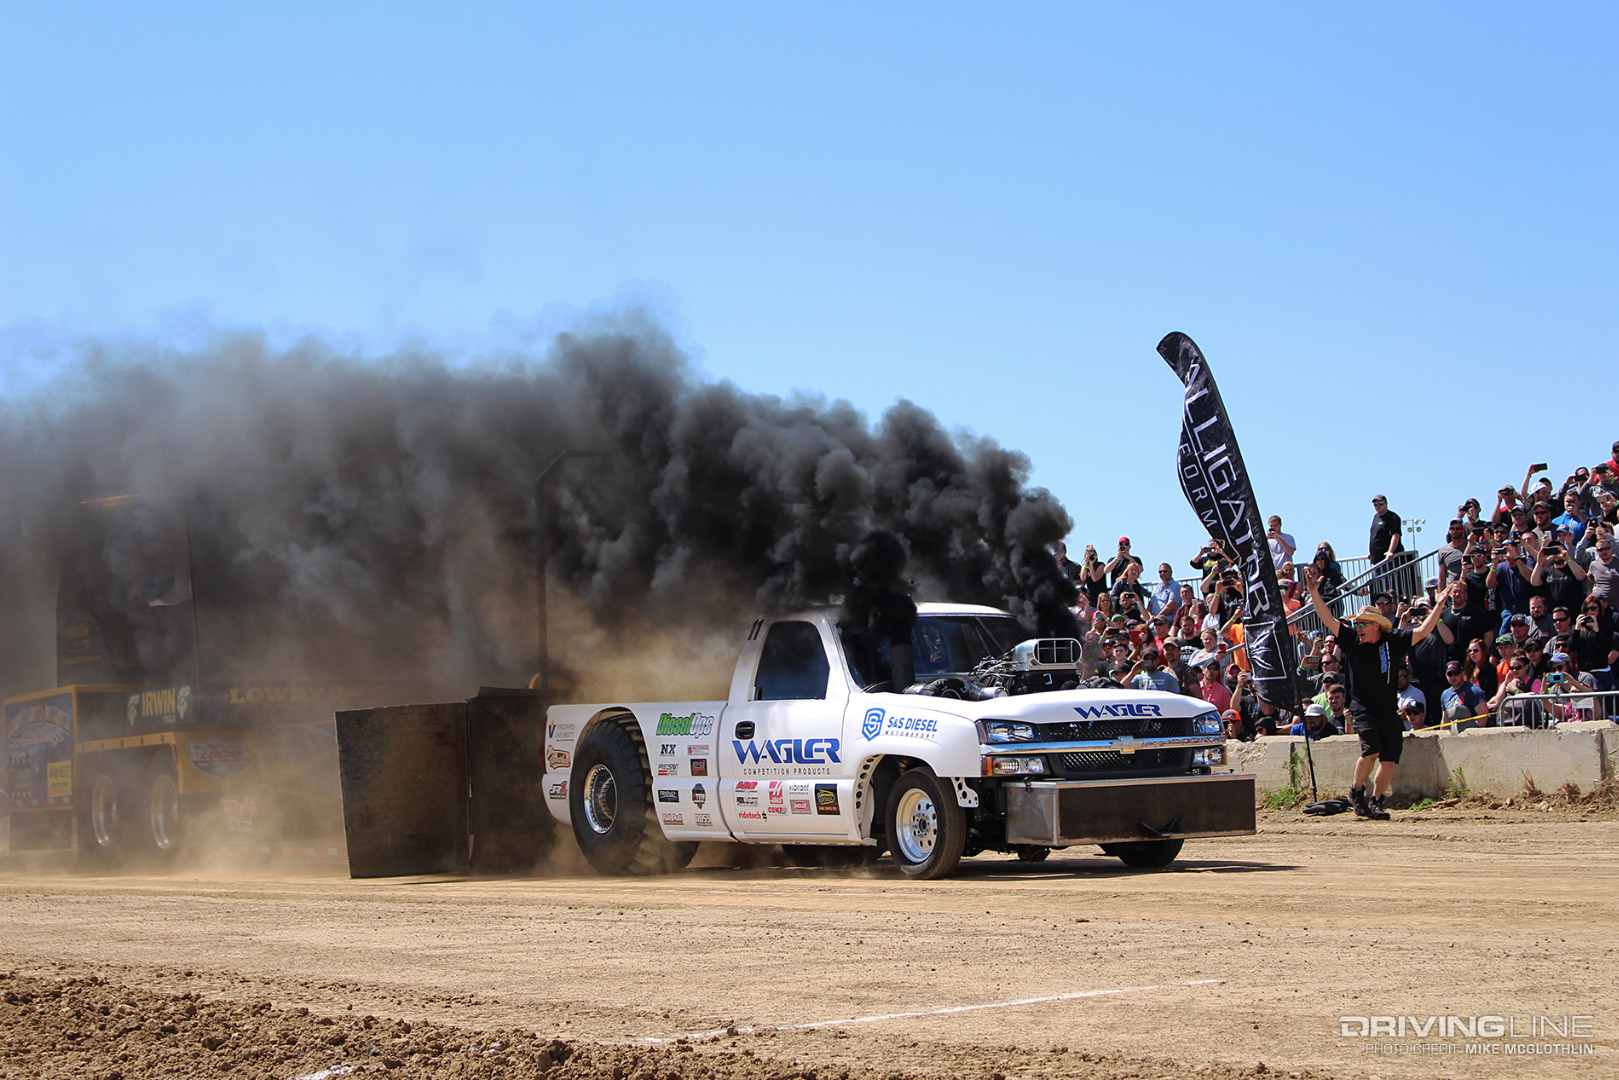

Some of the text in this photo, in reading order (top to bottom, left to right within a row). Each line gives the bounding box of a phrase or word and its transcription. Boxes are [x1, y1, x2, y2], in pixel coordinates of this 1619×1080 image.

[141, 688, 176, 717] IRWIN
[1074, 704, 1162, 719] WAGLER
[887, 716, 938, 732] S&S DIESEL
[885, 730, 935, 739] MOTORSPORT
[660, 744, 677, 755] NX
[732, 738, 841, 765] WAGLER
[793, 767, 830, 775] PRODUCTS
[738, 811, 762, 820] ridetech
